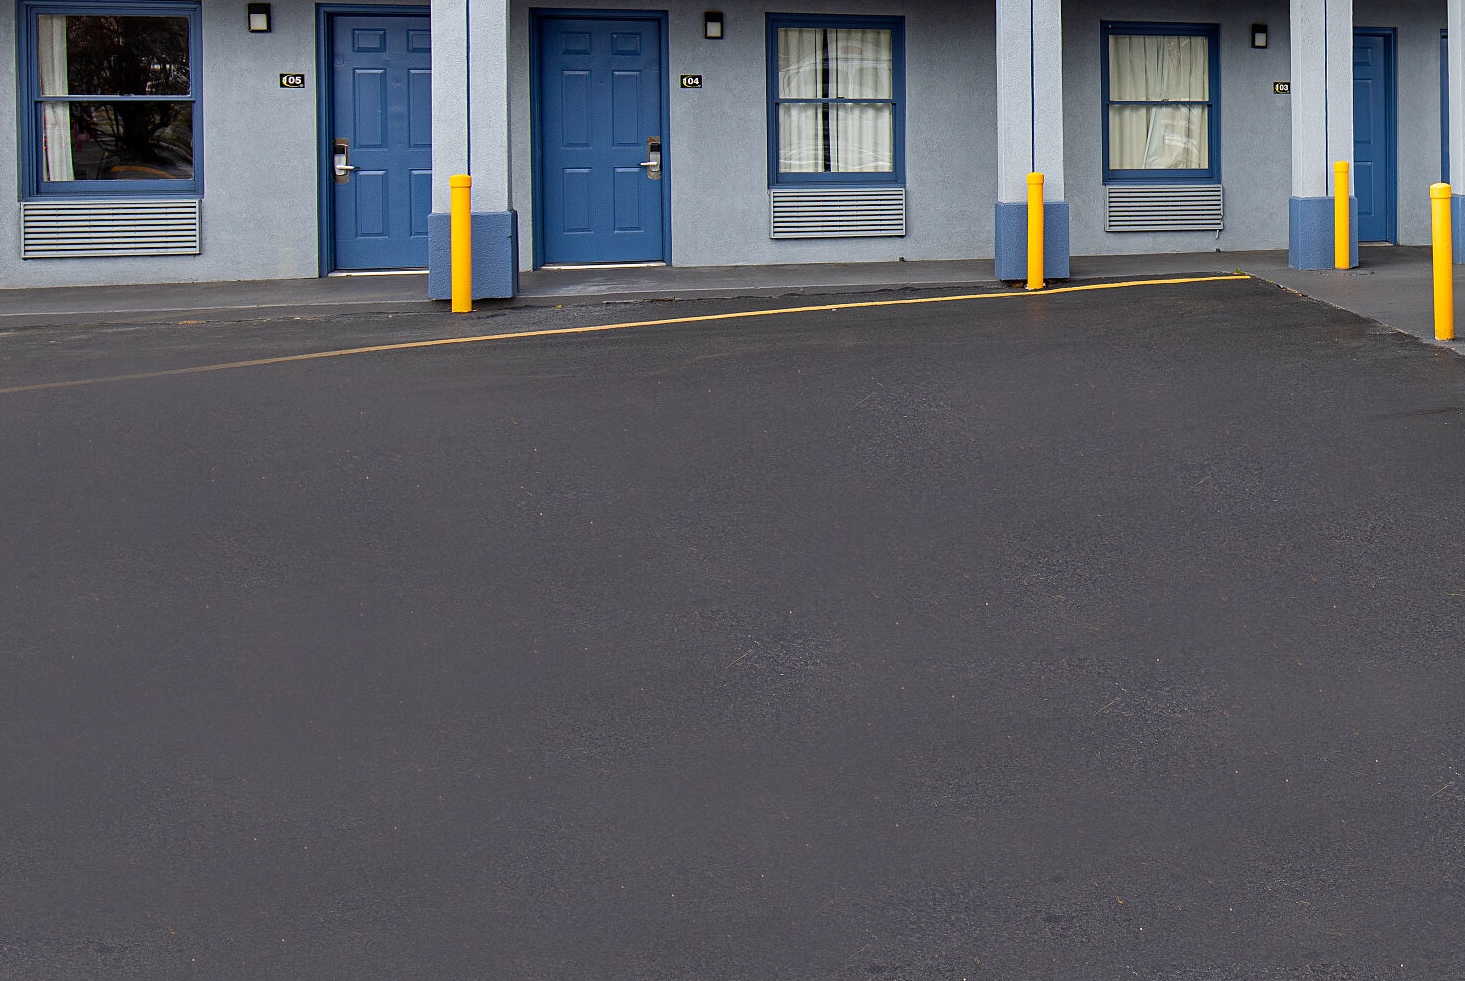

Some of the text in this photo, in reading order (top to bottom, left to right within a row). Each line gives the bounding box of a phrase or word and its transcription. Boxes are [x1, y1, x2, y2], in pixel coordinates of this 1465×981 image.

[282, 76, 302, 85] 105
[682, 77, 700, 85] 104
[1275, 83, 1289, 91] 103
